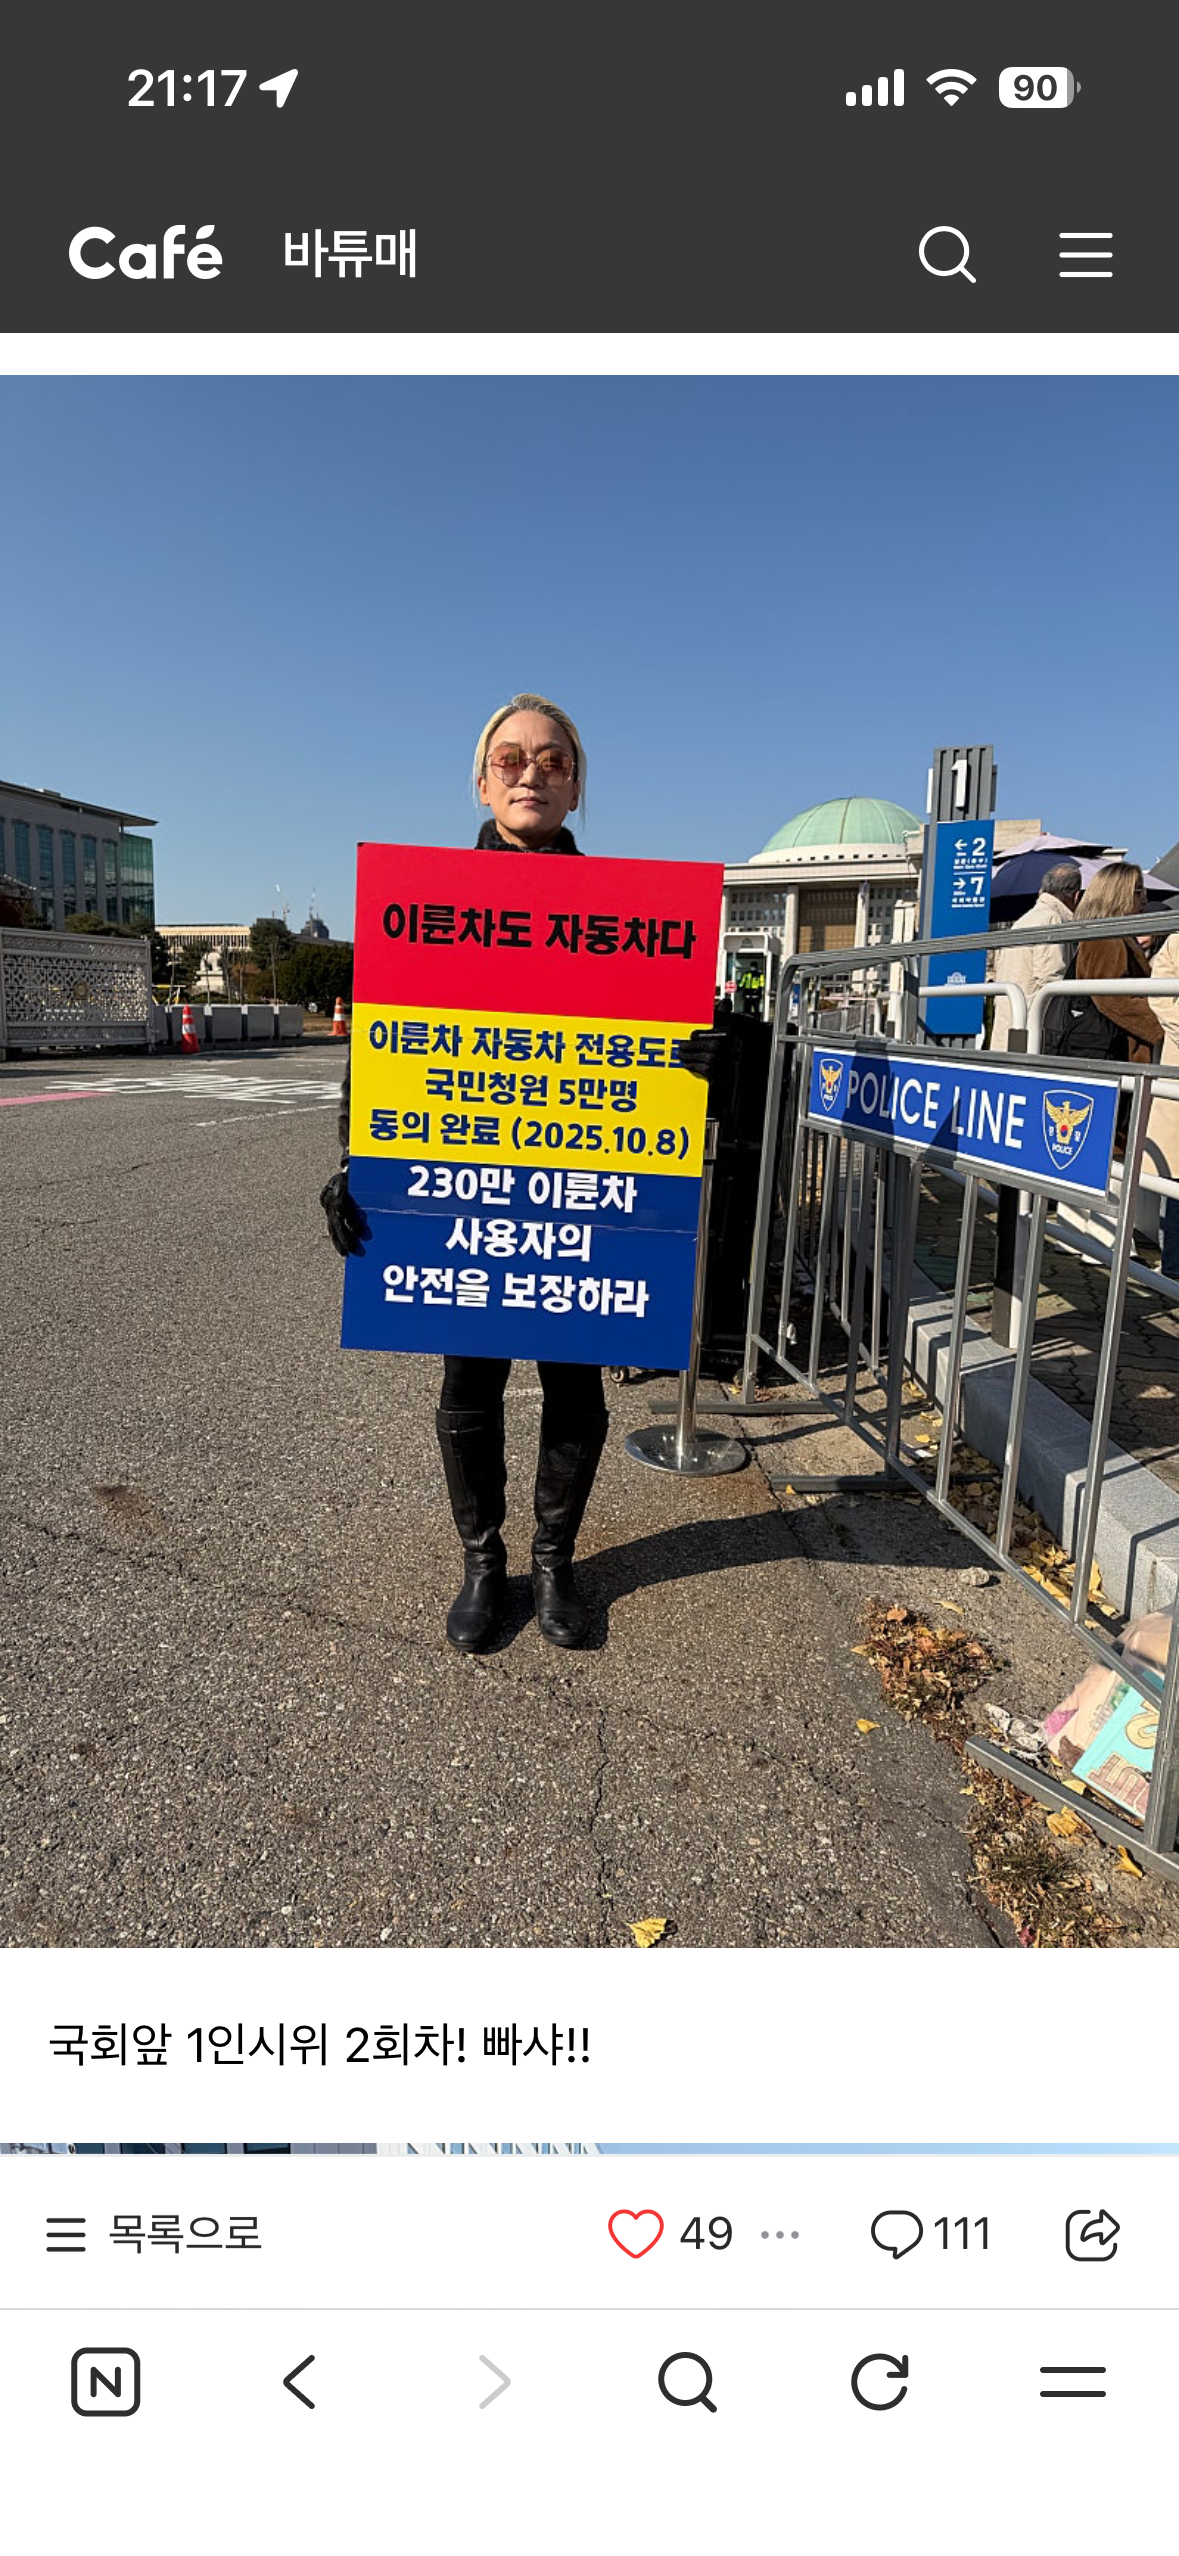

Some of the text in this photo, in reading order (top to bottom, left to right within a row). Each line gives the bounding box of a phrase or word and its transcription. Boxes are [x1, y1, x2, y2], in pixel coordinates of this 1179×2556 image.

[951, 759, 968, 808] 1
[972, 837, 986, 856] 2
[970, 877, 984, 895] 7
[382, 902, 697, 960] 이륜차도 자동차다
[369, 1020, 463, 1057] 이륜차
[471, 1025, 566, 1064] 자동차
[425, 1067, 638, 1113] 국민청원 5만명
[846, 1071, 1027, 1150] POLICE LINE
[369, 1108, 689, 1160] 동의 완료 (2025.10.8)
[407, 1164, 637, 1214] 230만 이륜차
[445, 1217, 592, 1262] 사용자의
[382, 1264, 650, 1318] 안전을 보장하라
